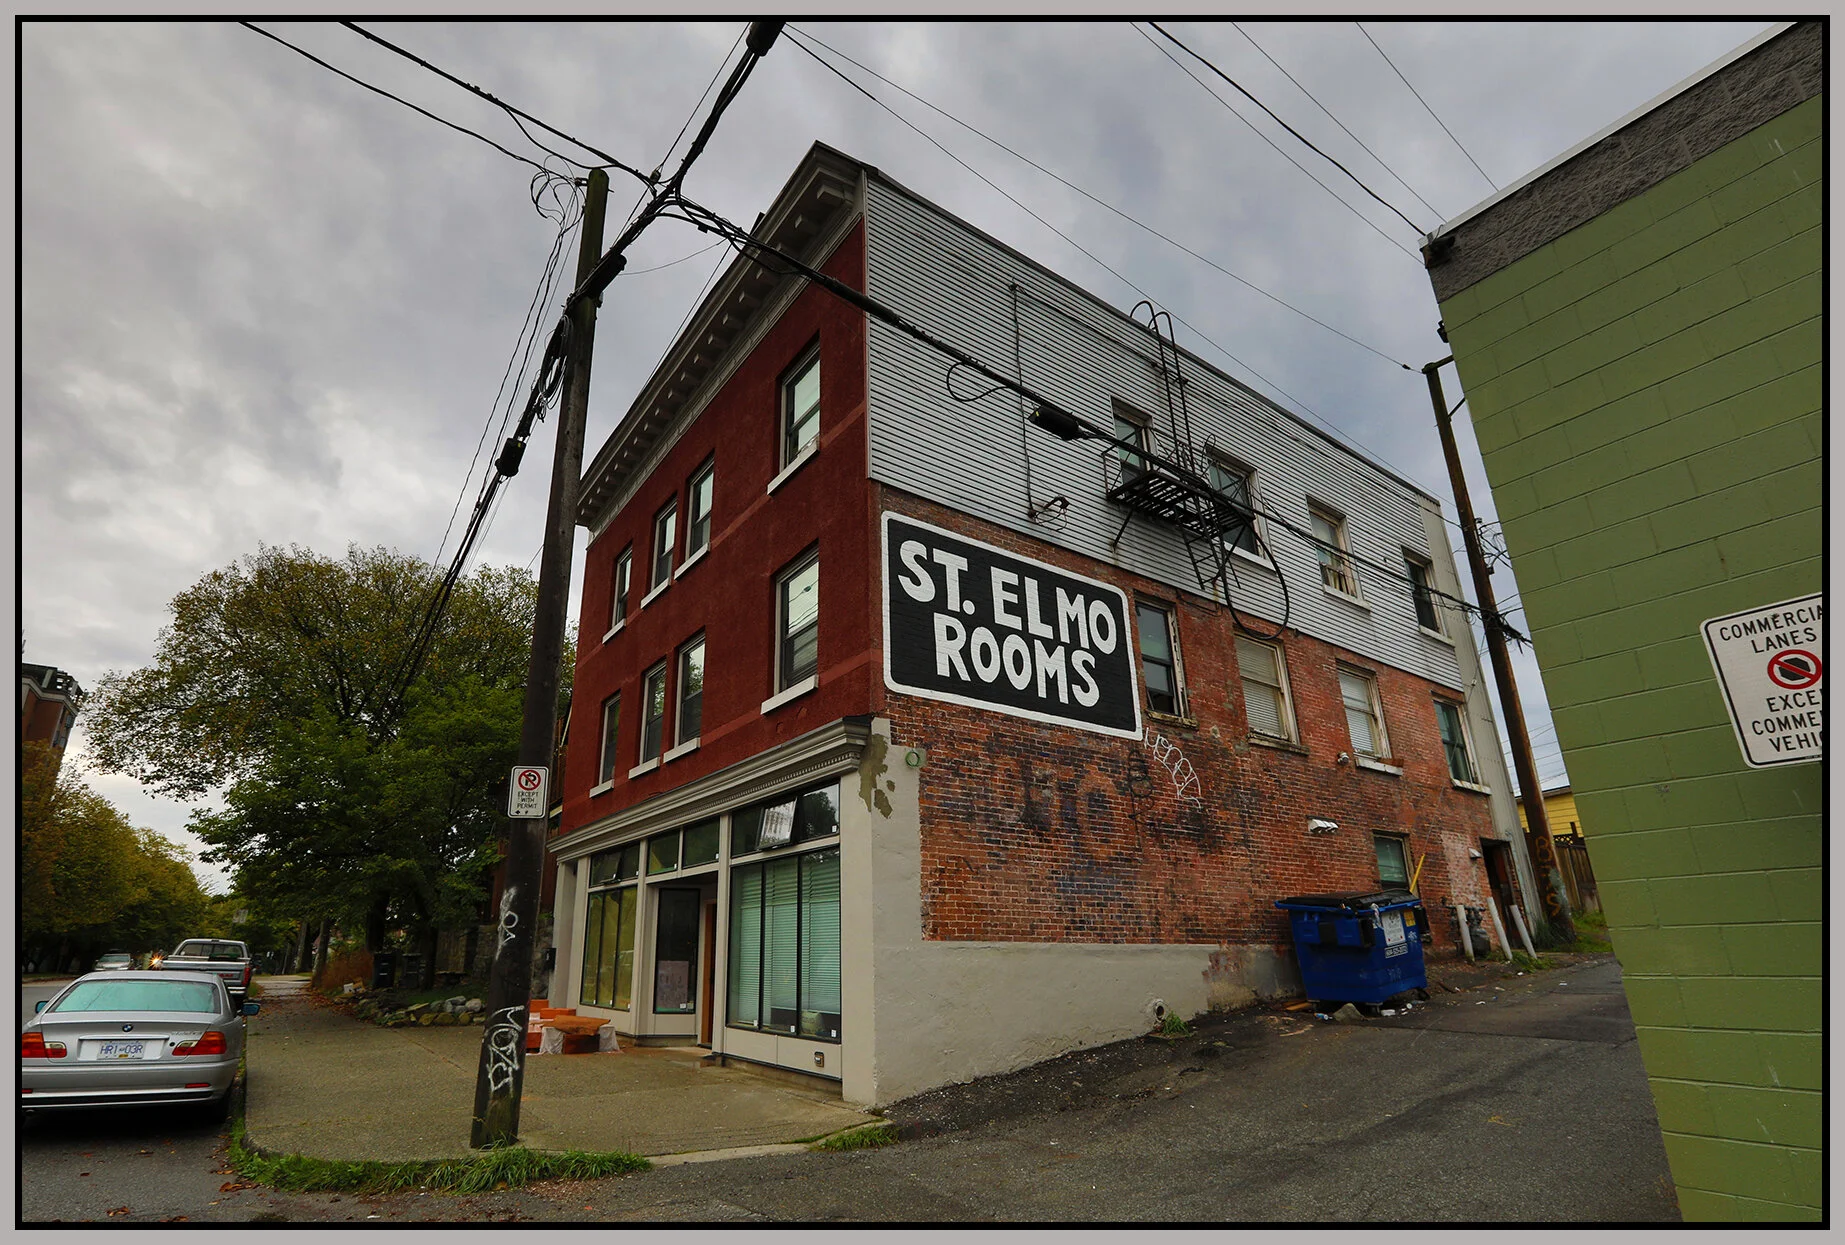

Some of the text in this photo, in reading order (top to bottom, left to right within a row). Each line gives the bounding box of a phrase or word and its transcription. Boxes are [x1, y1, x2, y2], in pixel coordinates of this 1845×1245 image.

[898, 540, 1117, 655] ST. ELMO
[1751, 627, 1817, 653] LANES
[933, 612, 1100, 707] ROOMS
[1766, 689, 1822, 712] EXCE
[1752, 710, 1822, 735] COMME
[1769, 731, 1822, 752] VEHI
